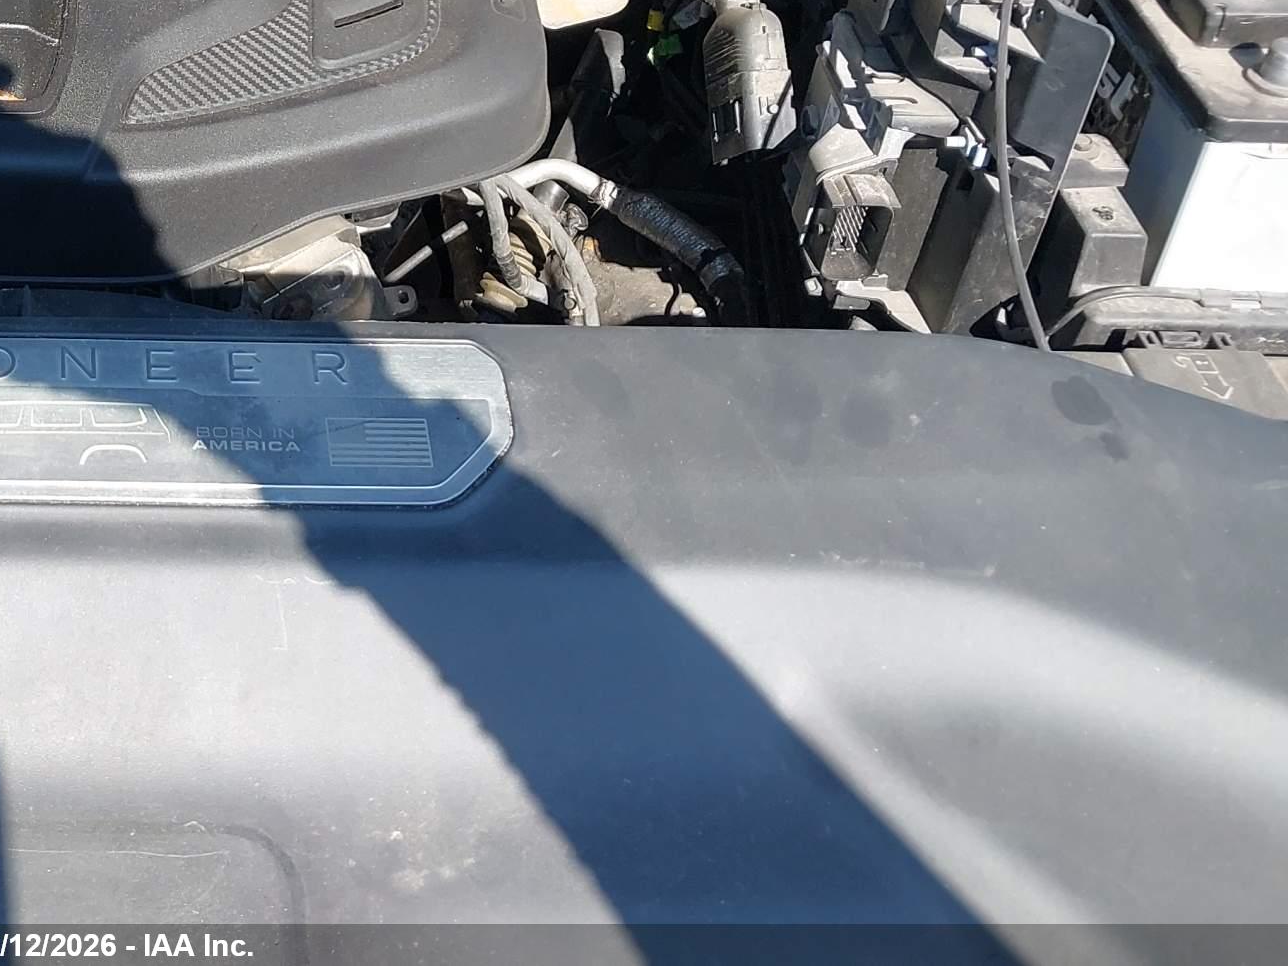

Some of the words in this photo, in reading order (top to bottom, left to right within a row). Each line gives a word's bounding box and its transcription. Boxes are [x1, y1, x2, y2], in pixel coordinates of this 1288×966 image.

[196, 426, 262, 439] BORN
[272, 426, 295, 439] IN
[192, 440, 302, 453] AMERICA
